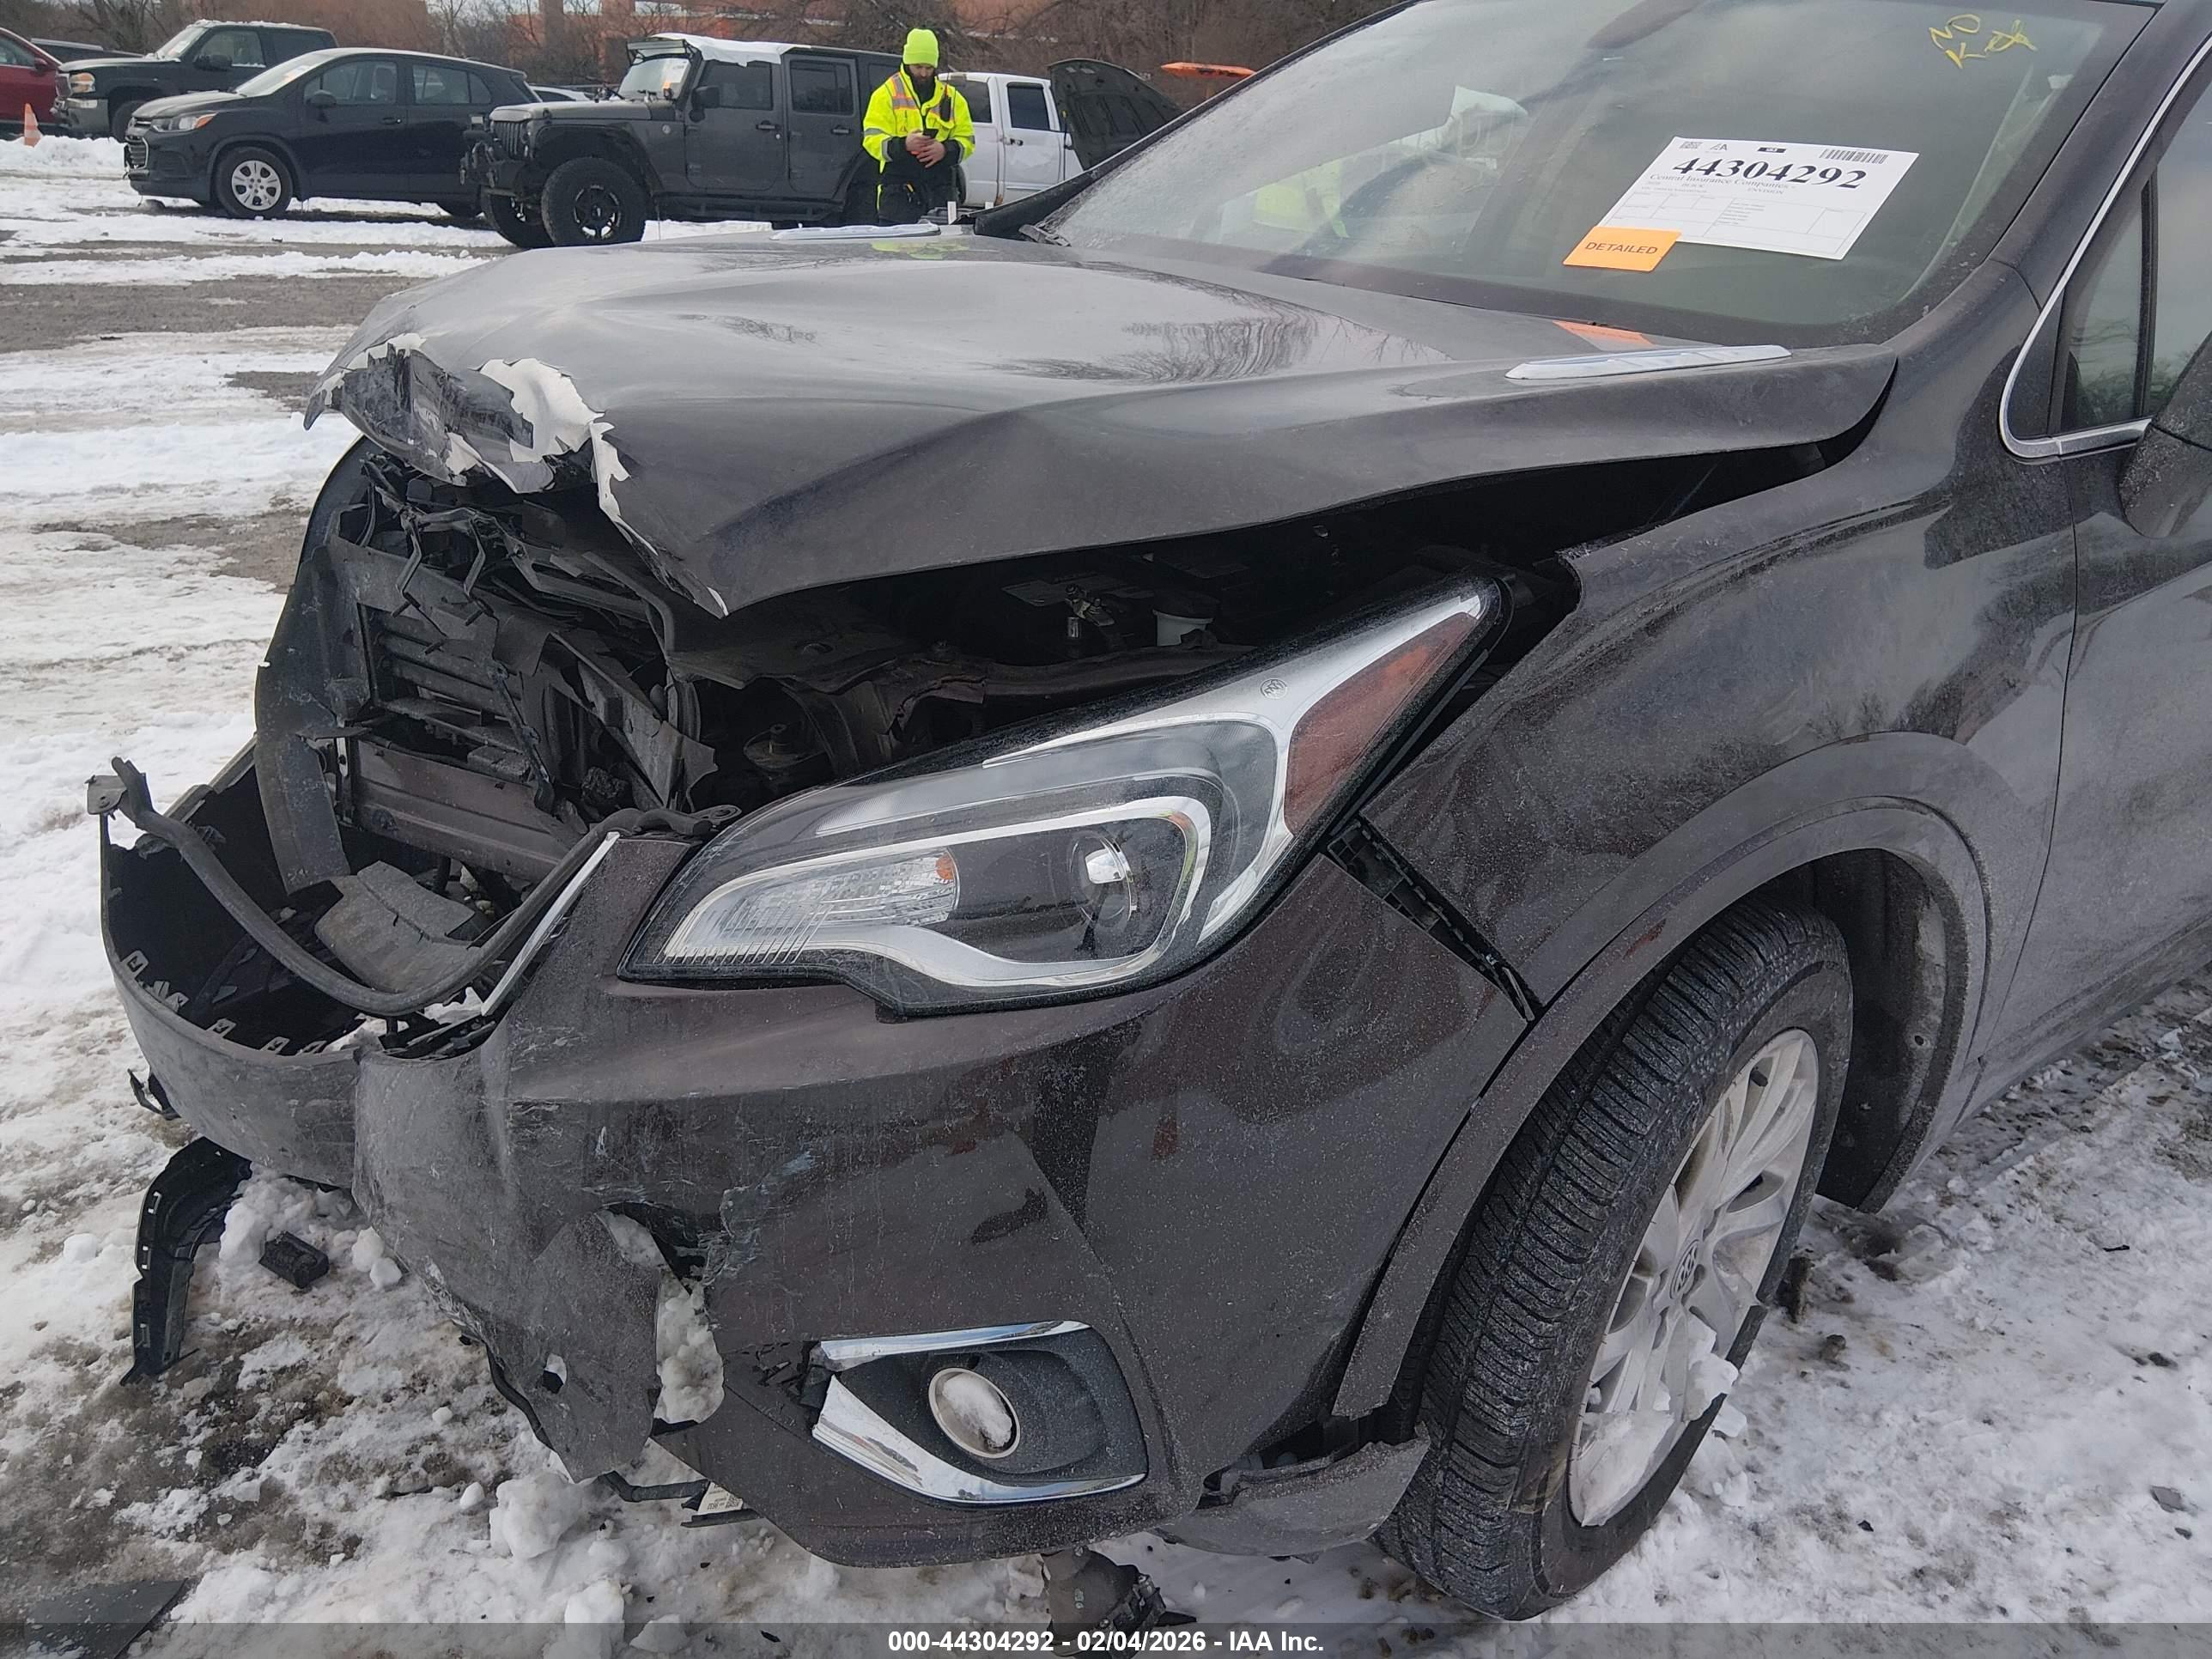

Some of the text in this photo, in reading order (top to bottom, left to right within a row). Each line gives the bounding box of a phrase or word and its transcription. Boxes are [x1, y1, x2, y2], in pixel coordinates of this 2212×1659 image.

[1672, 156, 1867, 189] 44304292
[1686, 175, 1733, 185] Insurance
[1584, 241, 1658, 255] DETAILED
